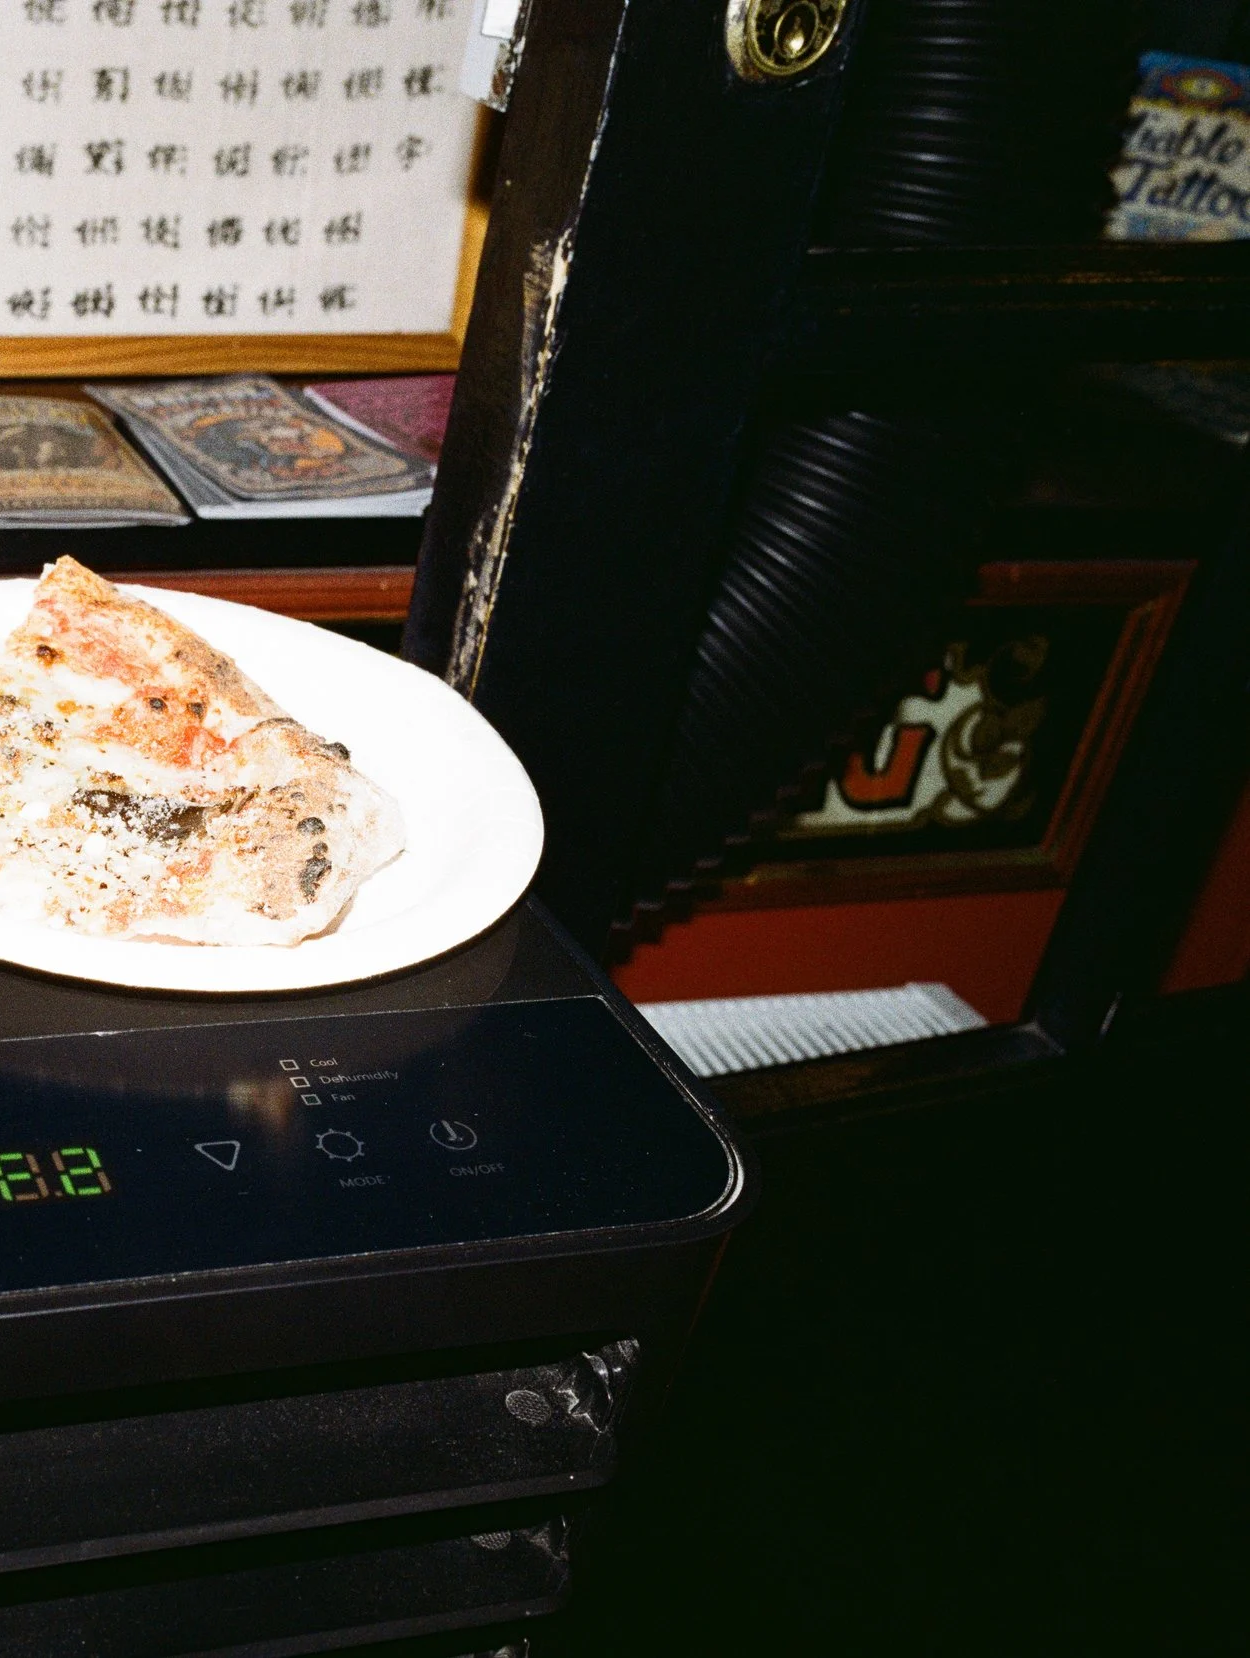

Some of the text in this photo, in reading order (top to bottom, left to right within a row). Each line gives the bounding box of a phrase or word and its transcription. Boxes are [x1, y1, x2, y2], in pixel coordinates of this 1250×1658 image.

[310, 1057, 338, 1068] Cool
[318, 1070, 399, 1086] Dehumidify
[331, 1093, 356, 1103] Fan
[450, 1163, 506, 1178] ON/OFF
[339, 1175, 386, 1189] MODE
